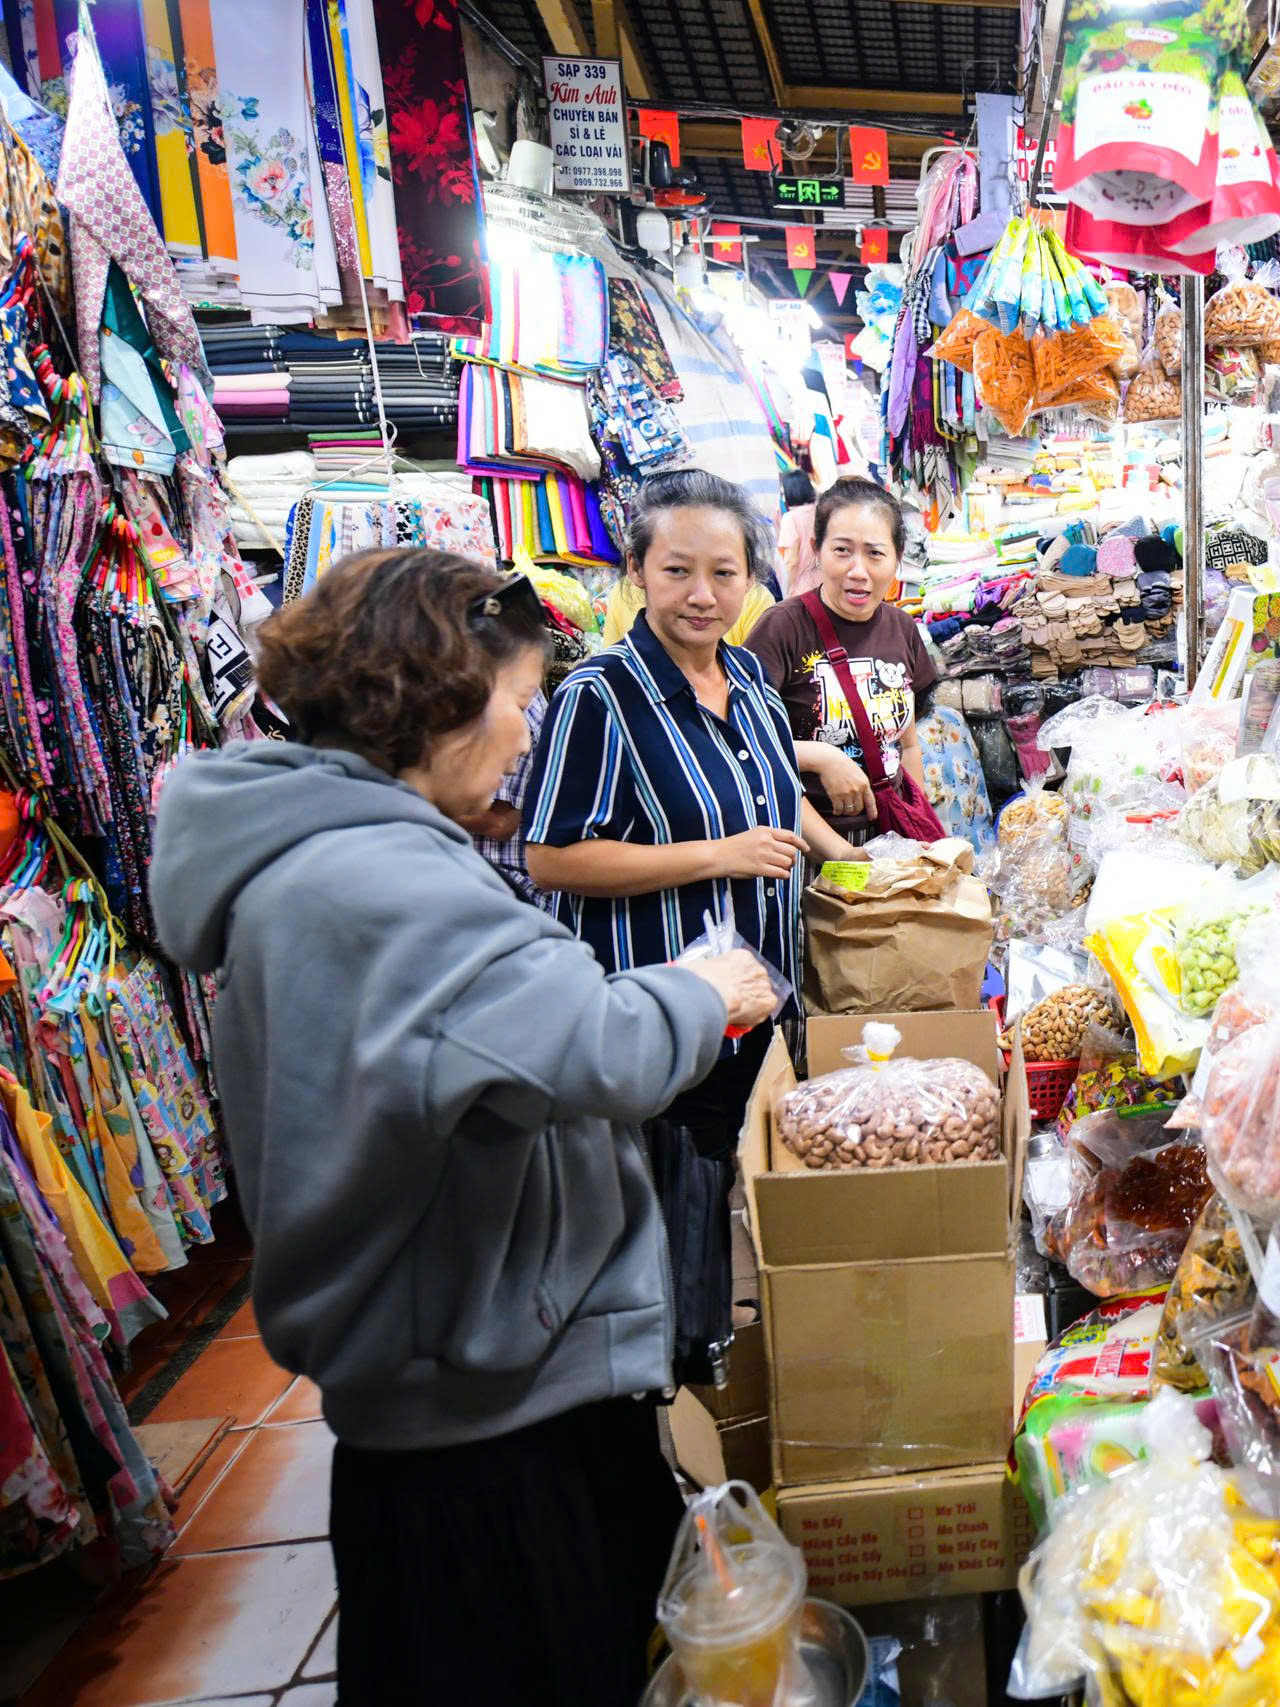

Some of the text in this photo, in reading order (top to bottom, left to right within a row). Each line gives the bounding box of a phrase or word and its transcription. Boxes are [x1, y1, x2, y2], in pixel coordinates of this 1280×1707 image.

[558, 63, 606, 80] SẠP 339
[551, 82, 617, 105] Kim Anh
[554, 107, 618, 123] CHUYÊN BÁN
[584, 128, 591, 140] &
[556, 142, 576, 157] CÁC
[580, 146, 602, 160] LOẠI
[573, 167, 622, 177] 0977.398.098
